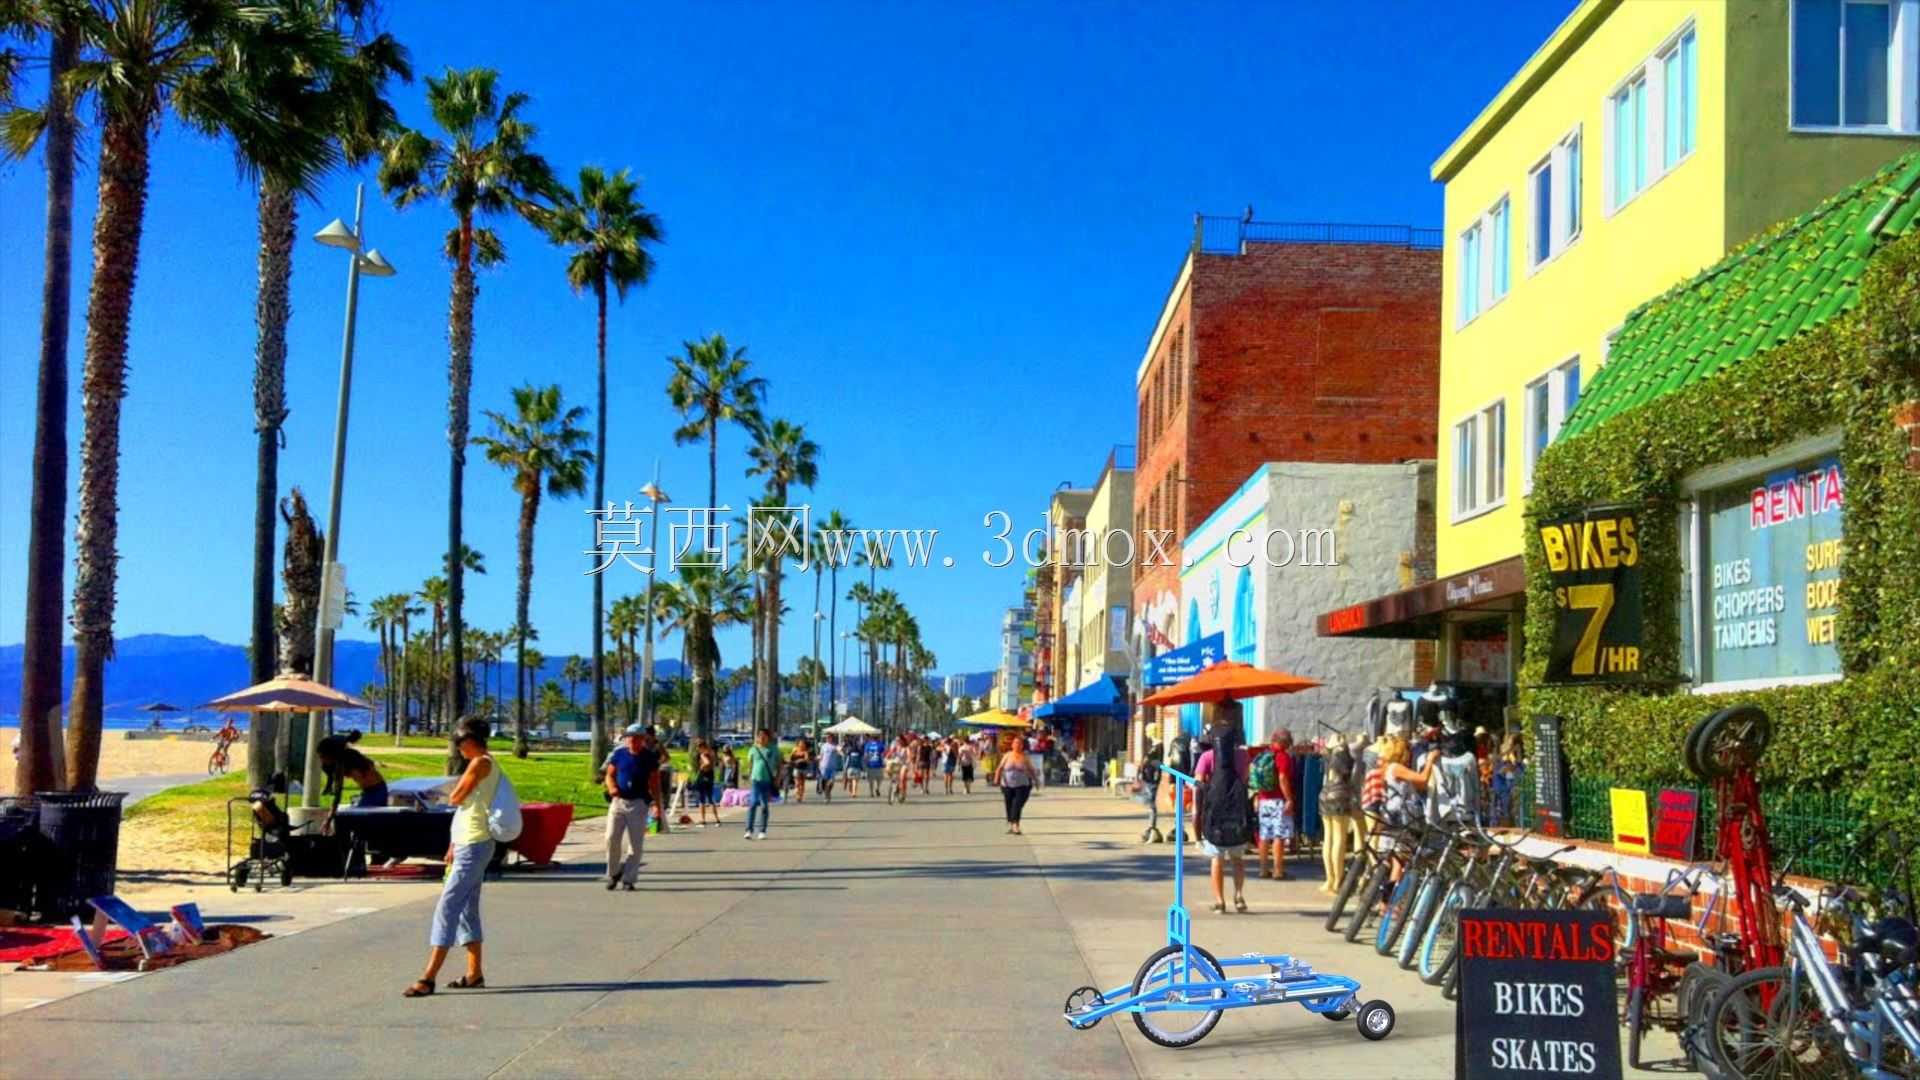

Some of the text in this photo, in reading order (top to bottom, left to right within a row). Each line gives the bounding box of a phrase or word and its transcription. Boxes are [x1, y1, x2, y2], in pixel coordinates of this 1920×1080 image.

[1540, 517, 1639, 573] BIKES
[1713, 558, 1752, 588] BIKES
[1713, 585, 1785, 621] CHOPPERS
[1713, 621, 1777, 650] TANDEMS
[1462, 918, 1615, 962] RENTALS
[1494, 981, 1585, 1018] BIKES
[1491, 1037, 1597, 1073] SKATES
